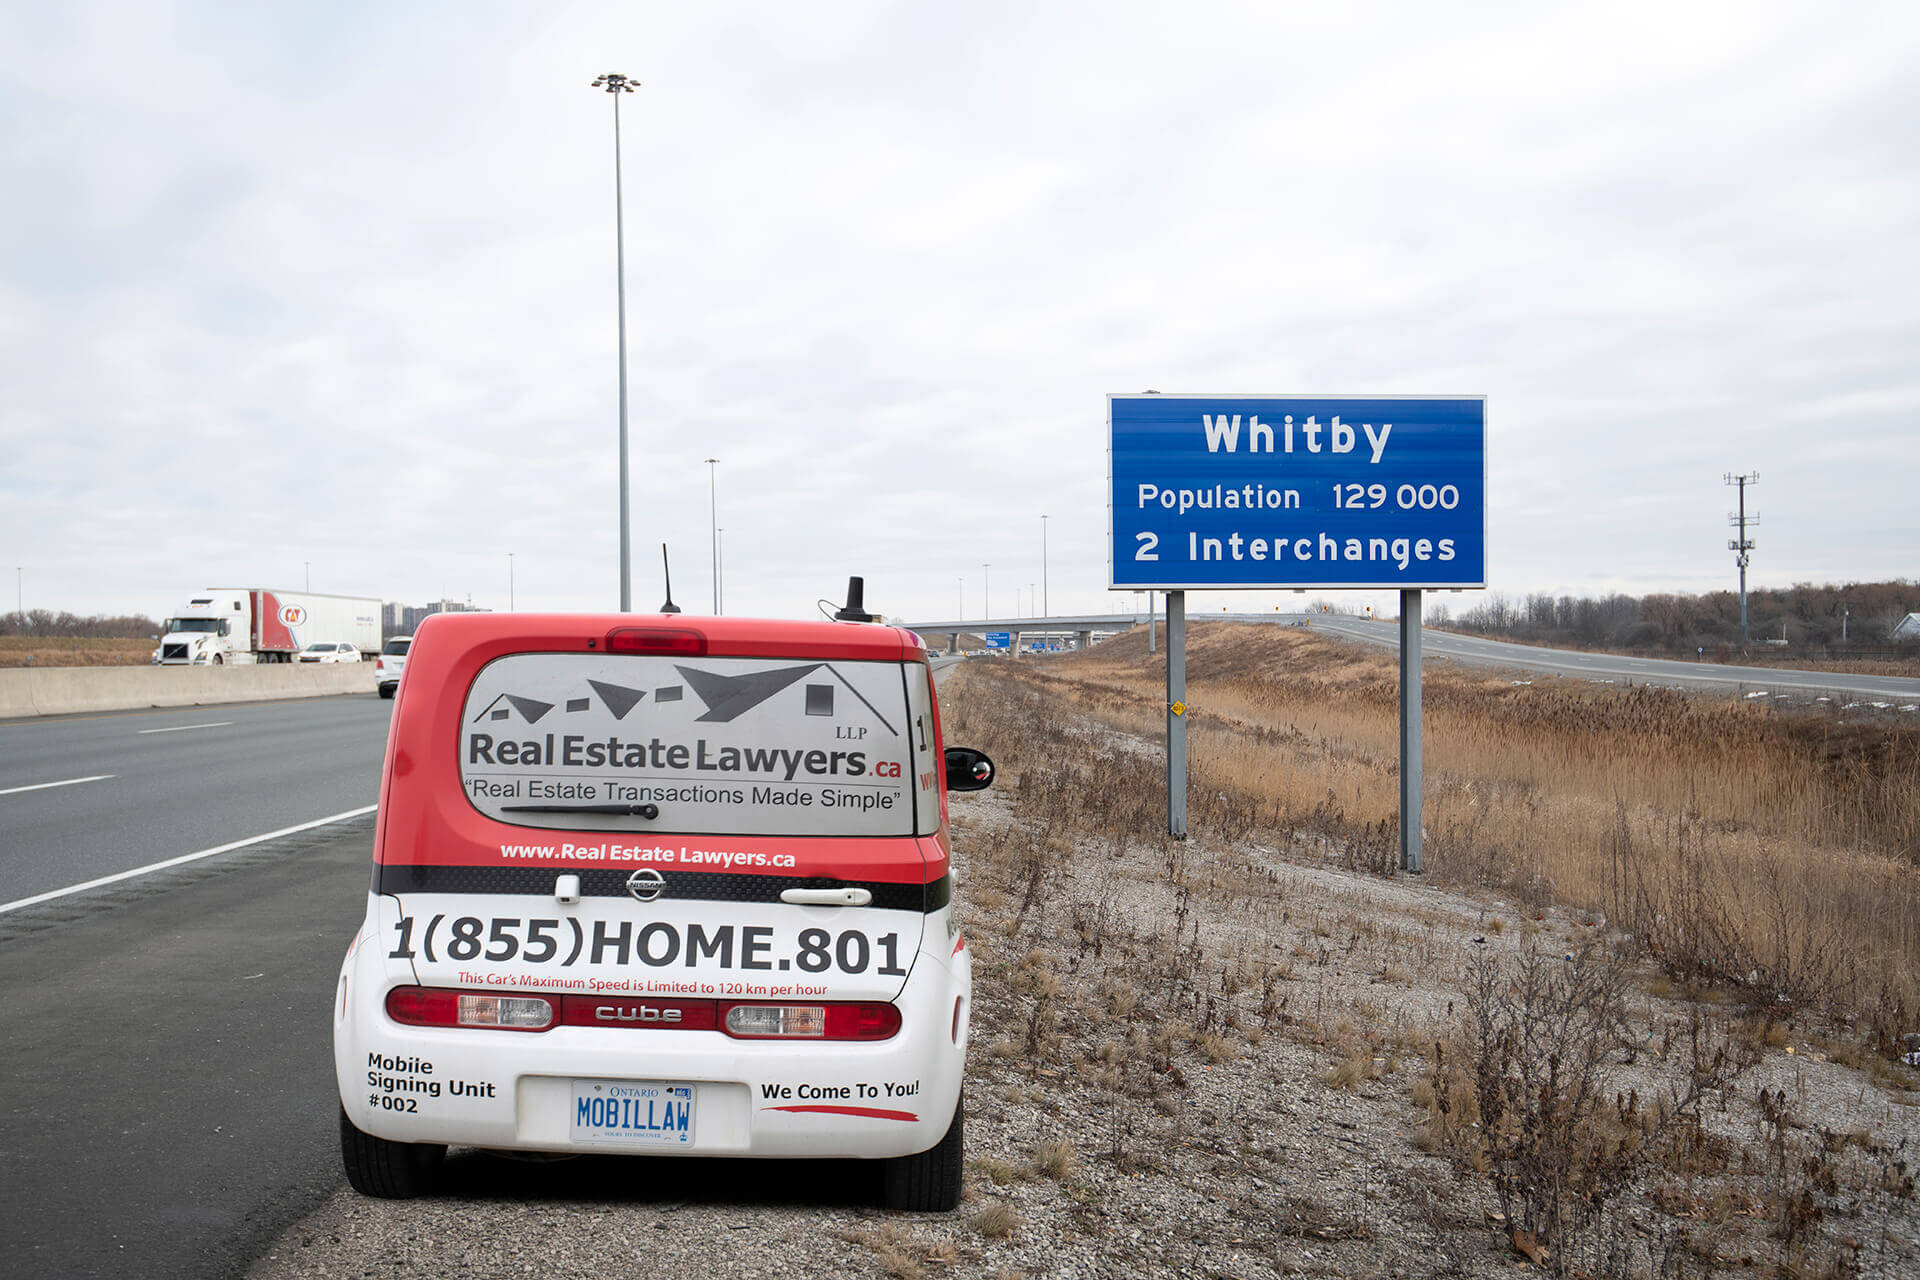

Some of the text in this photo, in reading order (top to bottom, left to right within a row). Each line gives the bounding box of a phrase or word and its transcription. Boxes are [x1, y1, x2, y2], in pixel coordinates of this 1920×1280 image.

[1202, 414, 1393, 464] Whitby
[1138, 483, 1460, 515] Population 129 000
[1134, 531, 1456, 571] 2 Interchanges
[835, 726, 868, 740] LLP
[465, 779, 900, 812] “Real Estate Transactions Made Simple”
[629, 881, 664, 889] NISSAN
[458, 971, 484, 984] This
[519, 975, 585, 989] Maximum
[589, 977, 630, 992] Speed
[633, 979, 644, 991] is
[647, 980, 697, 993] Limited
[701, 984, 714, 994] to
[719, 983, 743, 994] 120
[746, 983, 767, 994] km
[770, 985, 793, 997] per
[796, 983, 828, 995] hour
[595, 1004, 683, 1022] cube
[367, 1071, 496, 1098] Signing Unit
[761, 1079, 920, 1099] We Come To You!
[369, 1093, 418, 1113] #002
[577, 1096, 690, 1131] MOBILLAW
